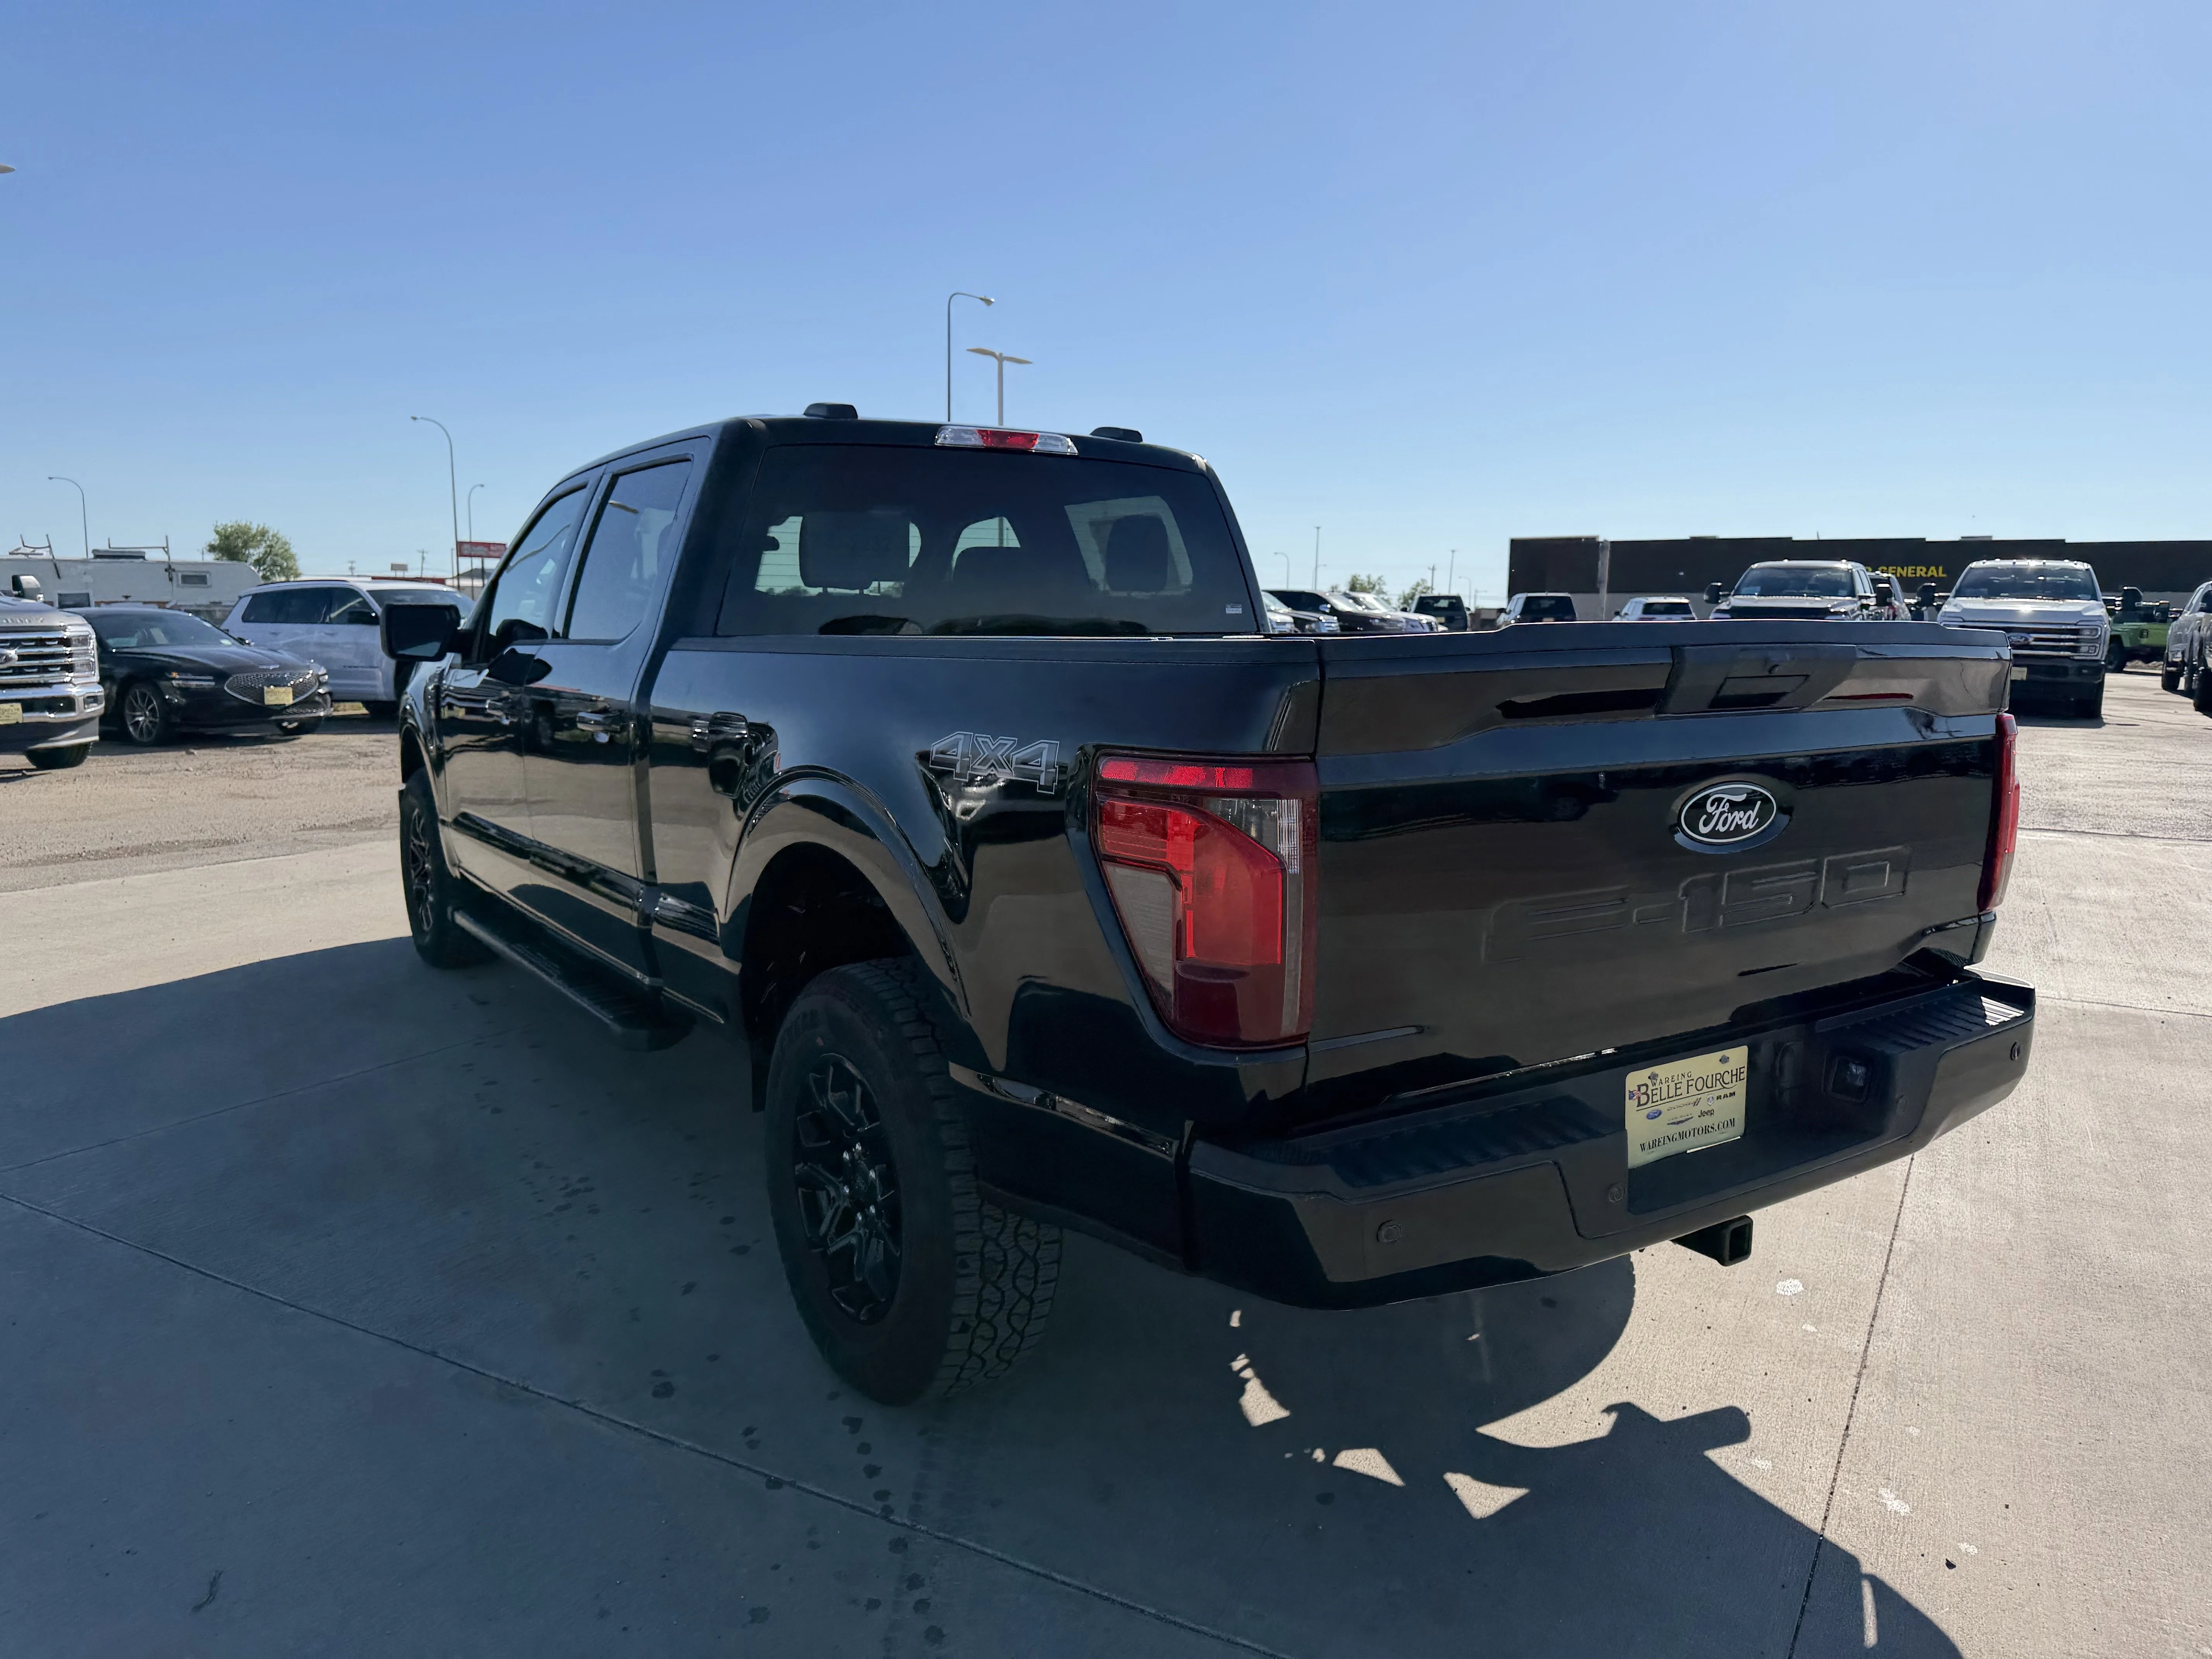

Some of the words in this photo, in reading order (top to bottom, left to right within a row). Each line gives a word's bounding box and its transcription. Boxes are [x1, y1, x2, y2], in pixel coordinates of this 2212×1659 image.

[1878, 566, 1947, 577] GENERAL
[1698, 792, 1761, 833] Ford
[1482, 844, 1911, 964] F-150
[1637, 1081, 1683, 1108] BELLE
[1686, 1066, 1745, 1094] FOURCHE
[1651, 1071, 1692, 1087] WAREING
[1716, 1091, 1736, 1101] RAM
[1698, 1108, 1714, 1118] Jeep
[1640, 1118, 1736, 1152] WAREINGMOTORS.COM
